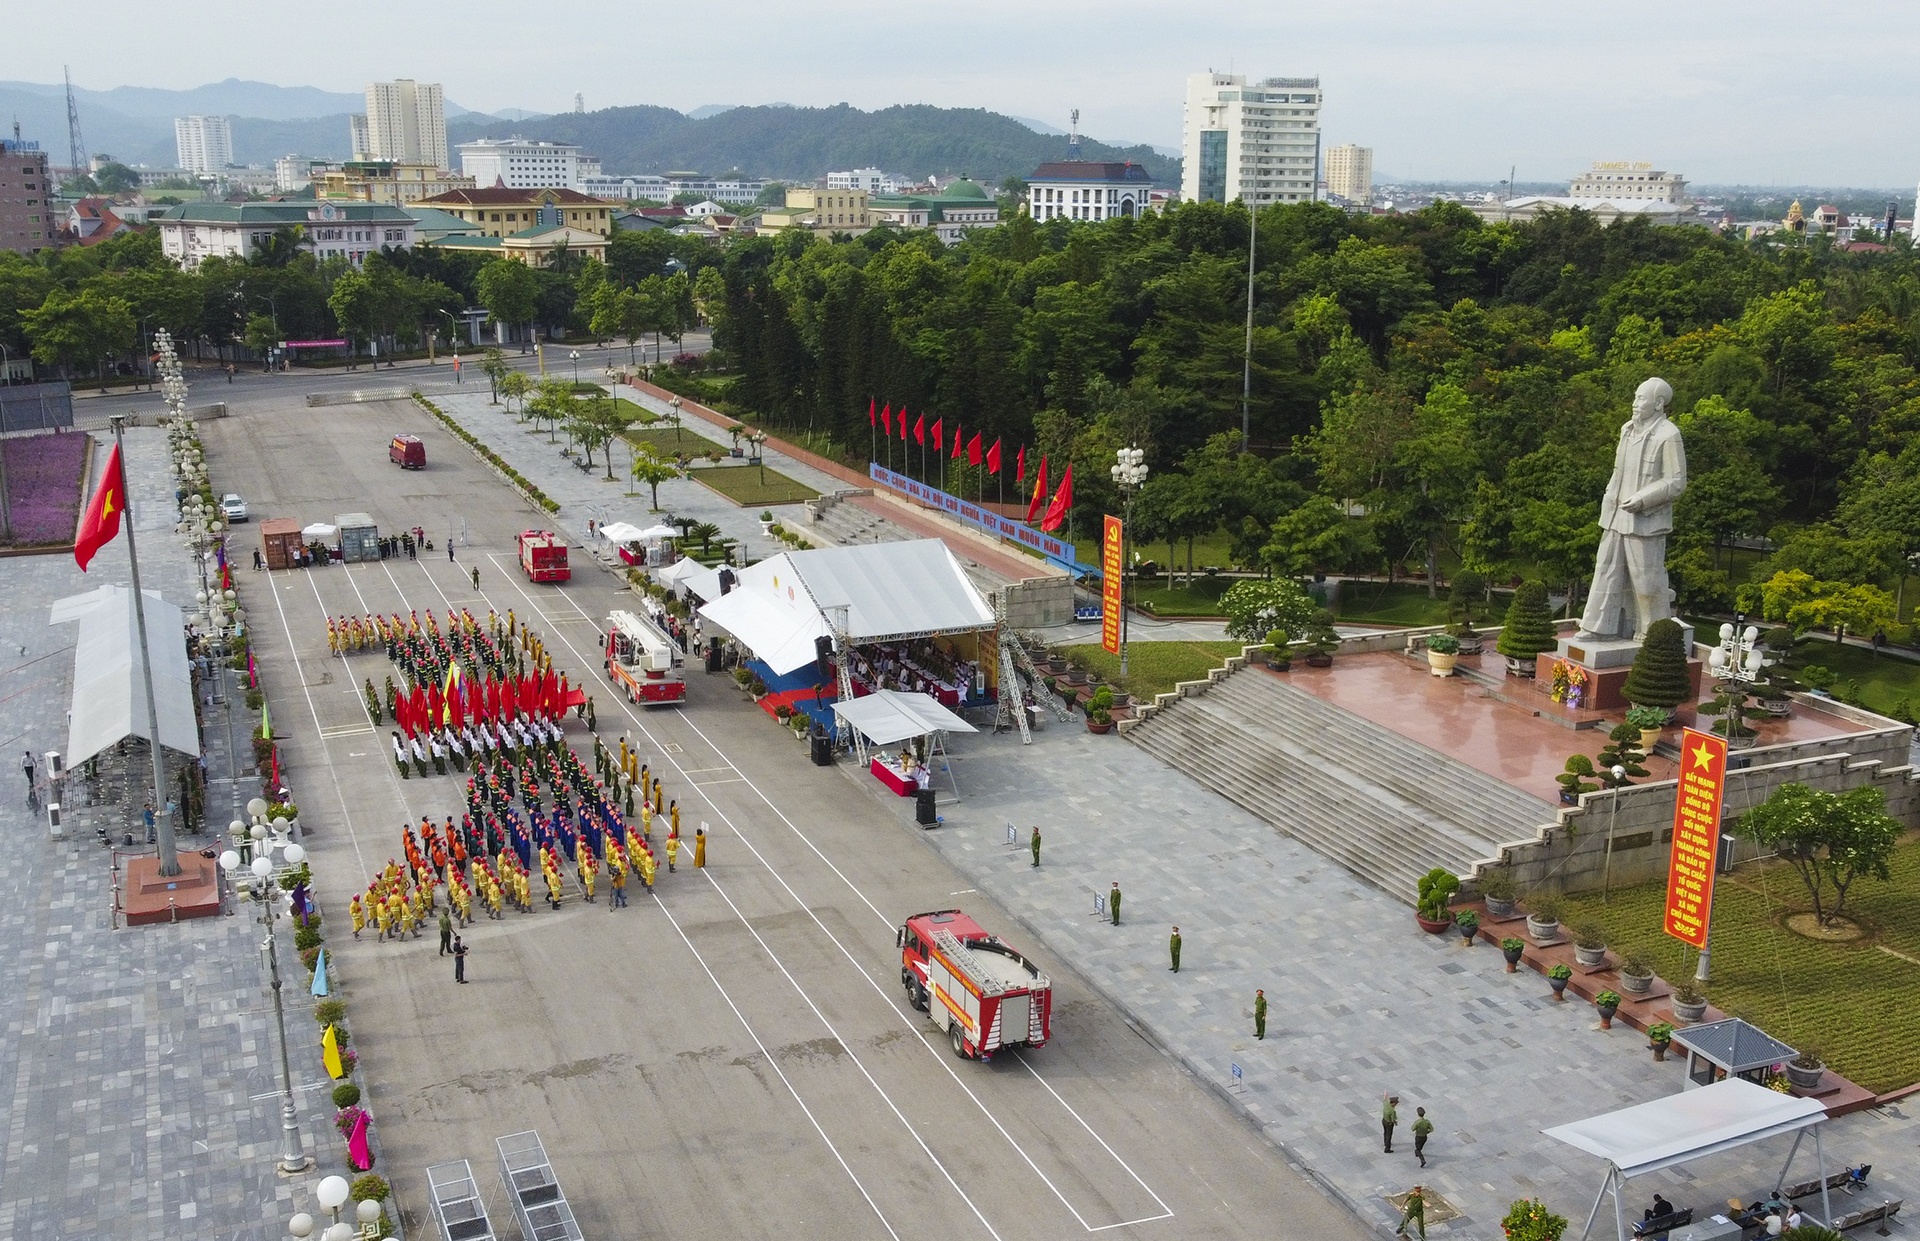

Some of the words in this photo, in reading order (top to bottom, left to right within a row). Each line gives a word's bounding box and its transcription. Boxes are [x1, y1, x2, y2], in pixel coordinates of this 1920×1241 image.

[1592, 161, 1630, 170] SUMMER
[945, 497, 958, 512] CHỦ
[960, 504, 980, 522] NGHĨA
[983, 512, 997, 529] VIỆT
[1000, 520, 1015, 537] NAM
[1018, 528, 1040, 548] MUÔN
[1043, 538, 1061, 556] NĂM
